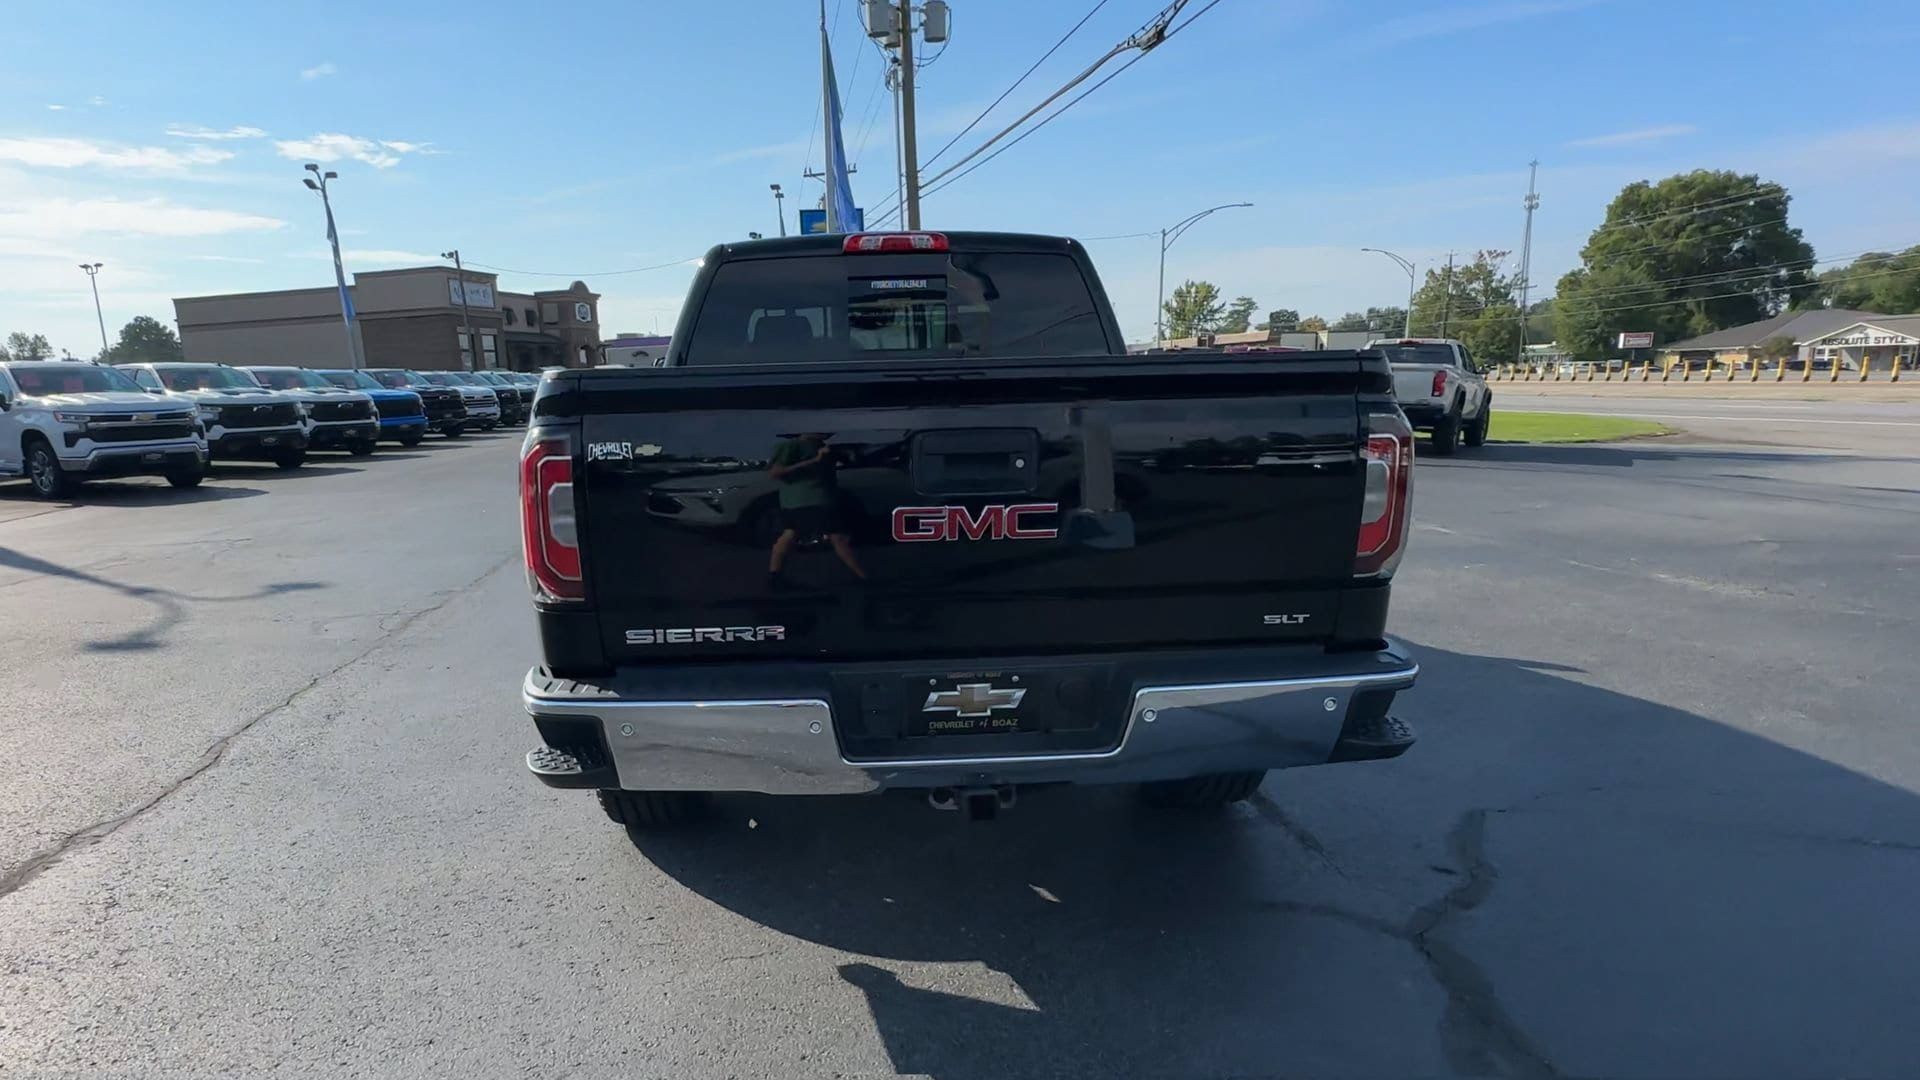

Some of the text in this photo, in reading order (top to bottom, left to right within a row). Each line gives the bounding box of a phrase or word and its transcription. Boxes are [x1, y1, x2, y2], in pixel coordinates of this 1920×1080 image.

[1821, 336, 1907, 345] ABSOLUTE STYLE
[588, 442, 633, 462] CHEVROLET
[892, 502, 1058, 542] GMC
[1264, 614, 1310, 624] SLT
[625, 625, 786, 644] SIERRA
[929, 720, 975, 729] CHEVROLET
[992, 718, 1019, 727] BOAZ
